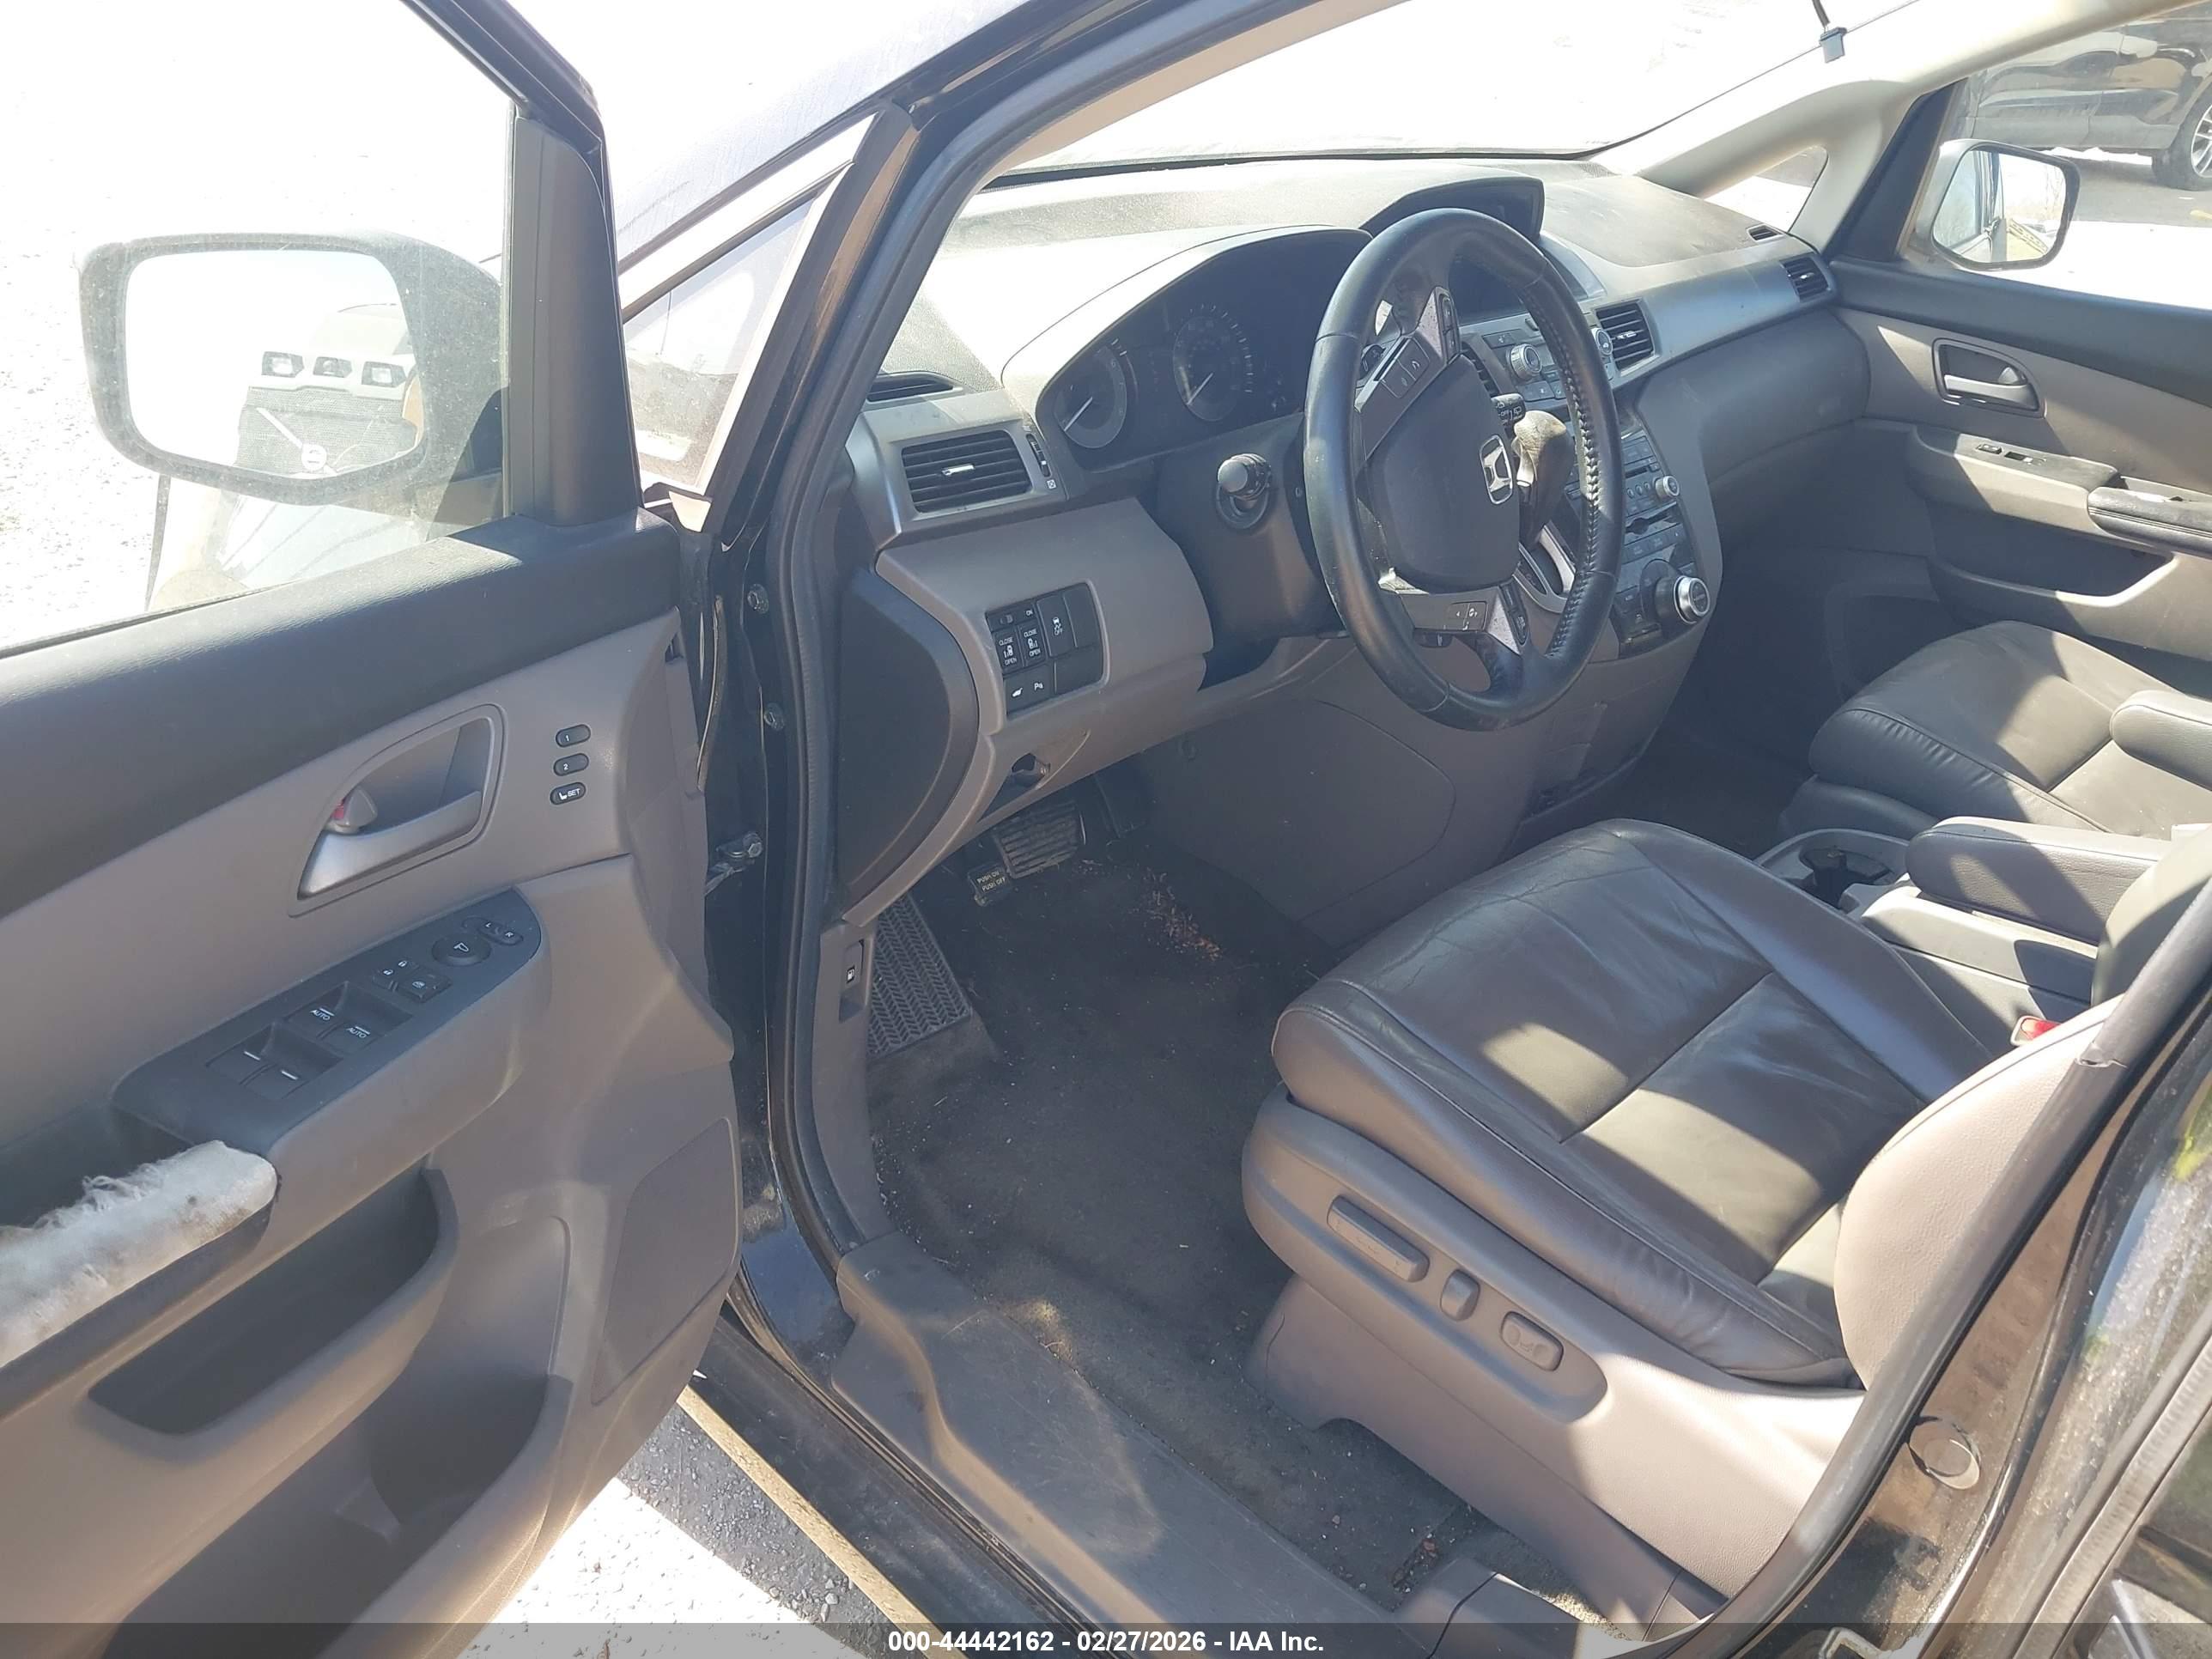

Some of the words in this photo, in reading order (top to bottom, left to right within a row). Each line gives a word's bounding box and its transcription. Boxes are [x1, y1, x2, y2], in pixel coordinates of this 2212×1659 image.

[1024, 629, 1037, 637] CLOSE
[999, 636, 1013, 646] CLOSE
[1029, 648, 1042, 657] OPEN
[1005, 657, 1018, 665] OPEN
[567, 788, 580, 797] SET
[977, 874, 992, 884] PUSH
[981, 881, 996, 891] PUSH
[309, 1009, 330, 1020] AUTO
[345, 1027, 367, 1038] AUTO
